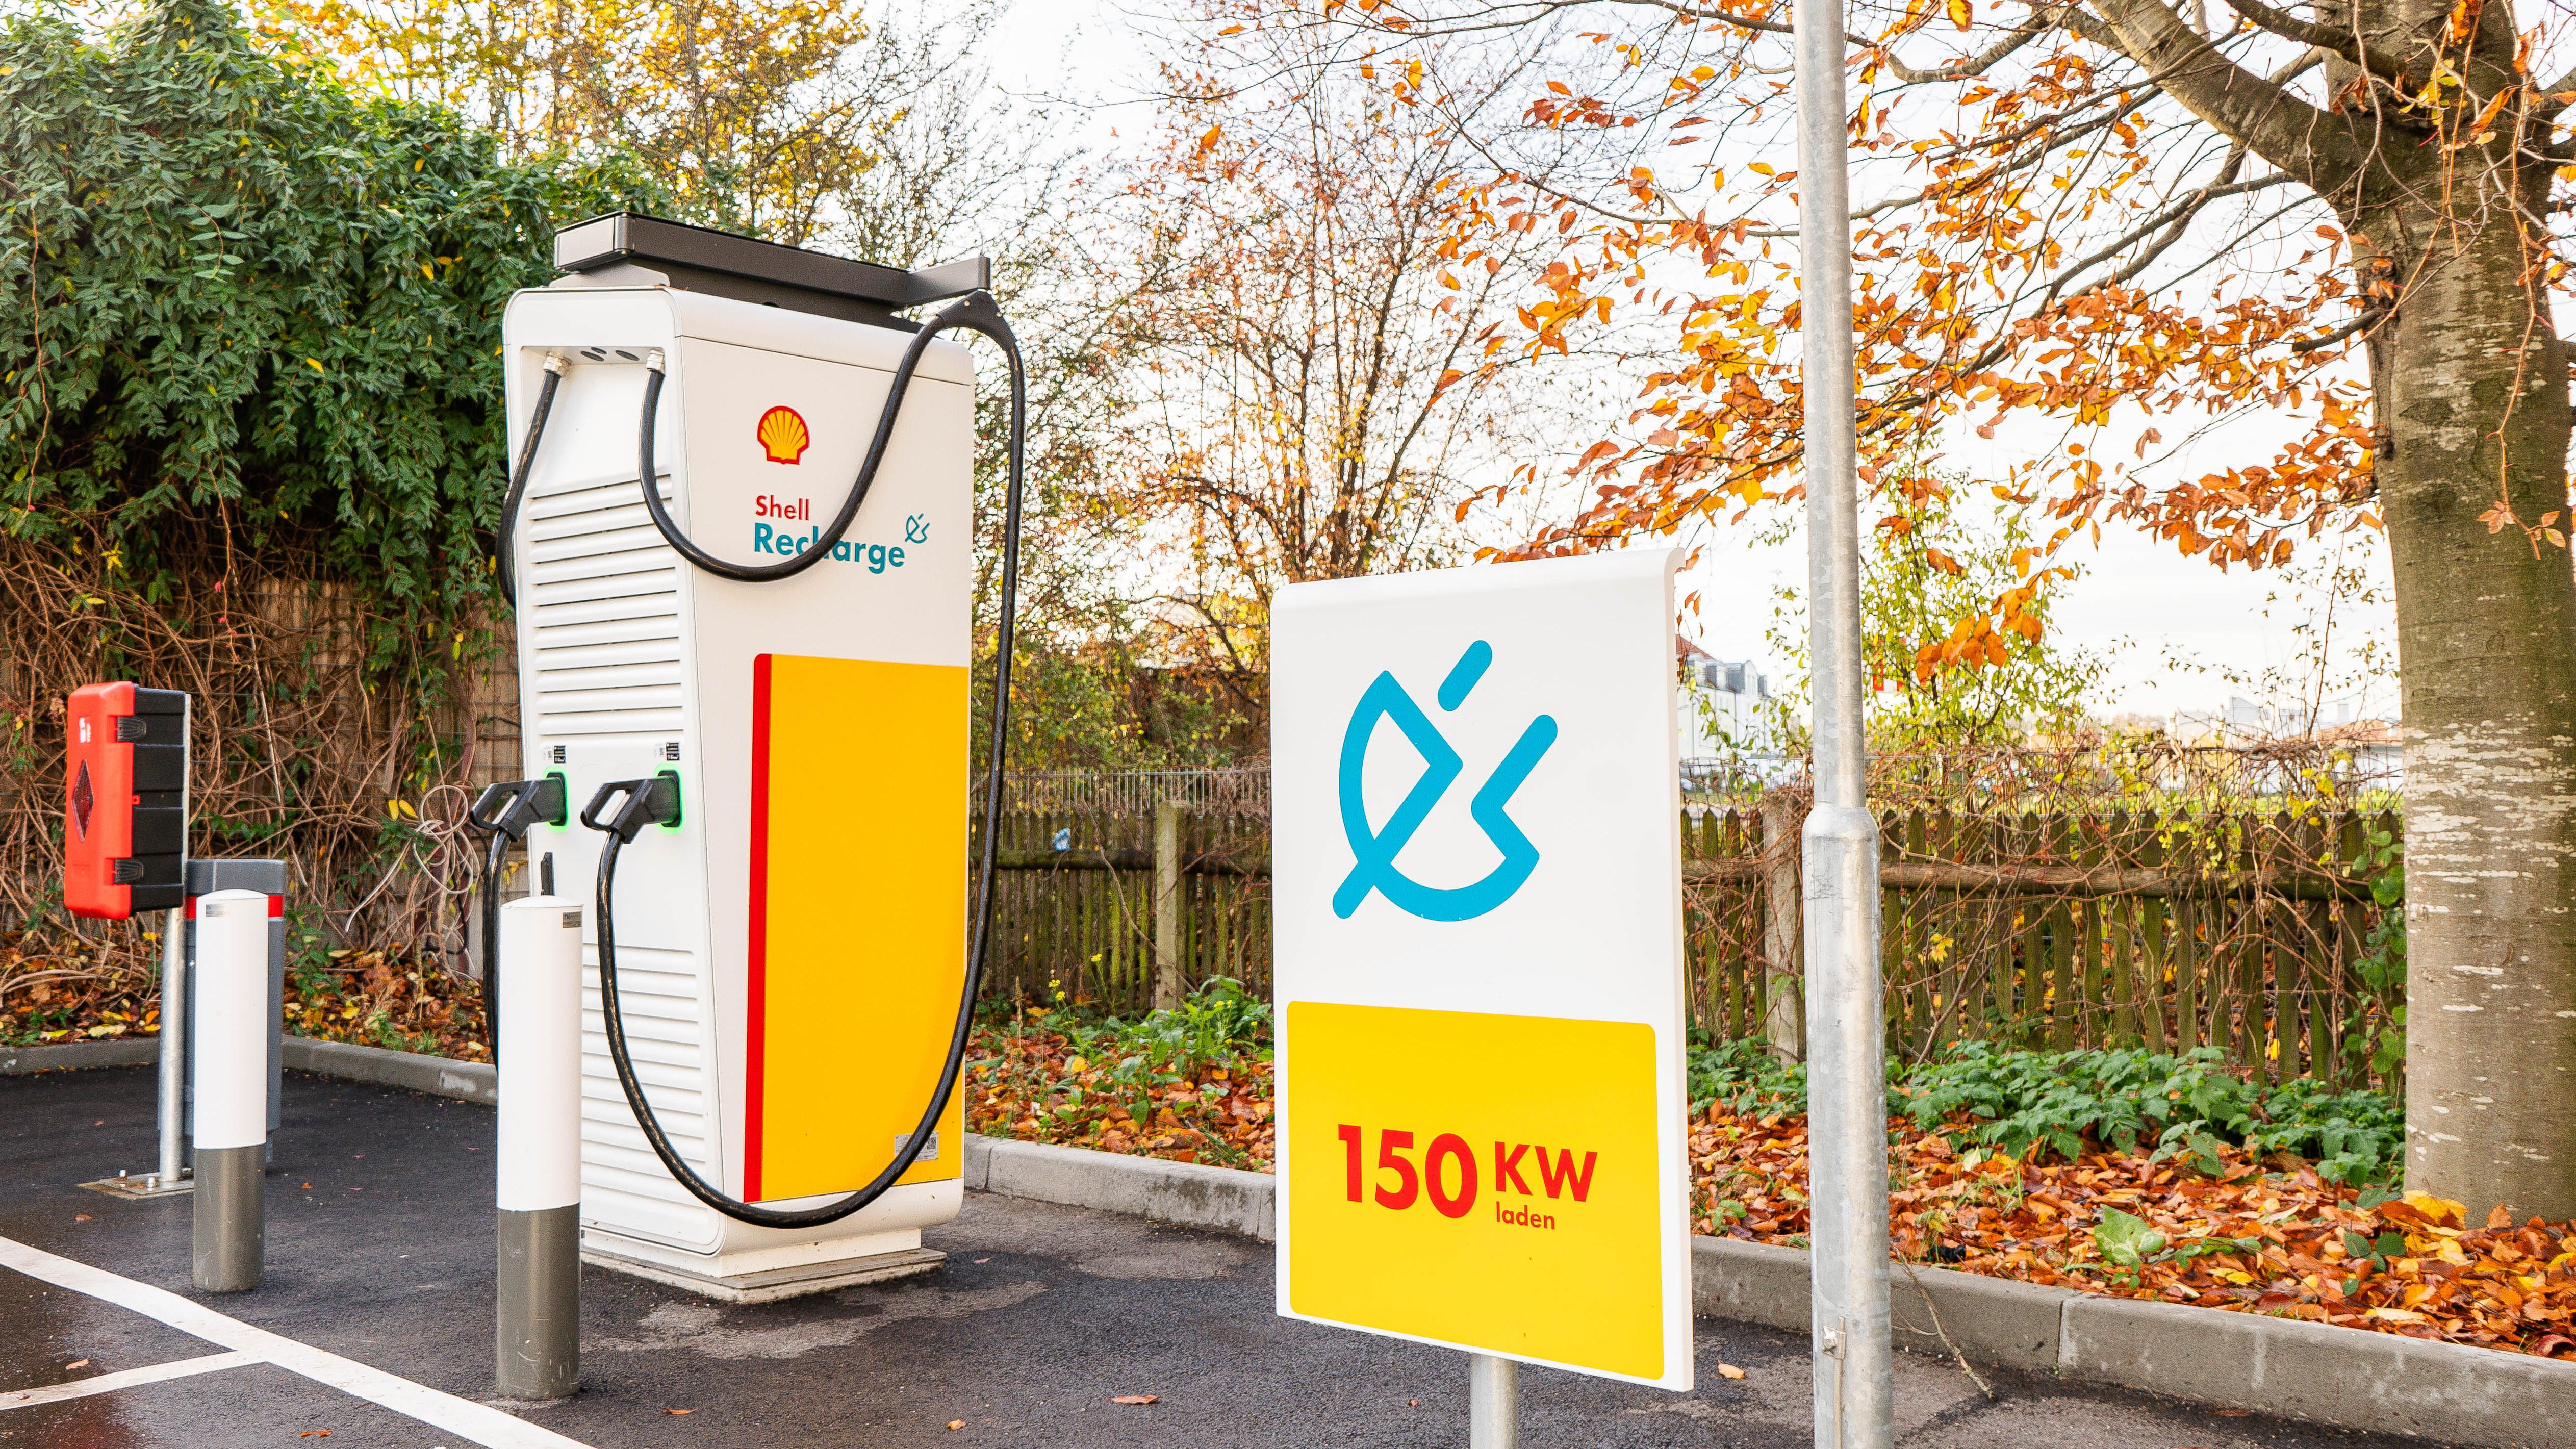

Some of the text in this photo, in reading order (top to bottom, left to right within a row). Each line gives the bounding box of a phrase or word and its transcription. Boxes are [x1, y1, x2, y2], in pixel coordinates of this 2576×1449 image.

[755, 494, 810, 521] Shell
[1338, 1124, 1598, 1218] 150 KW
[1496, 1201, 1555, 1230] laden
